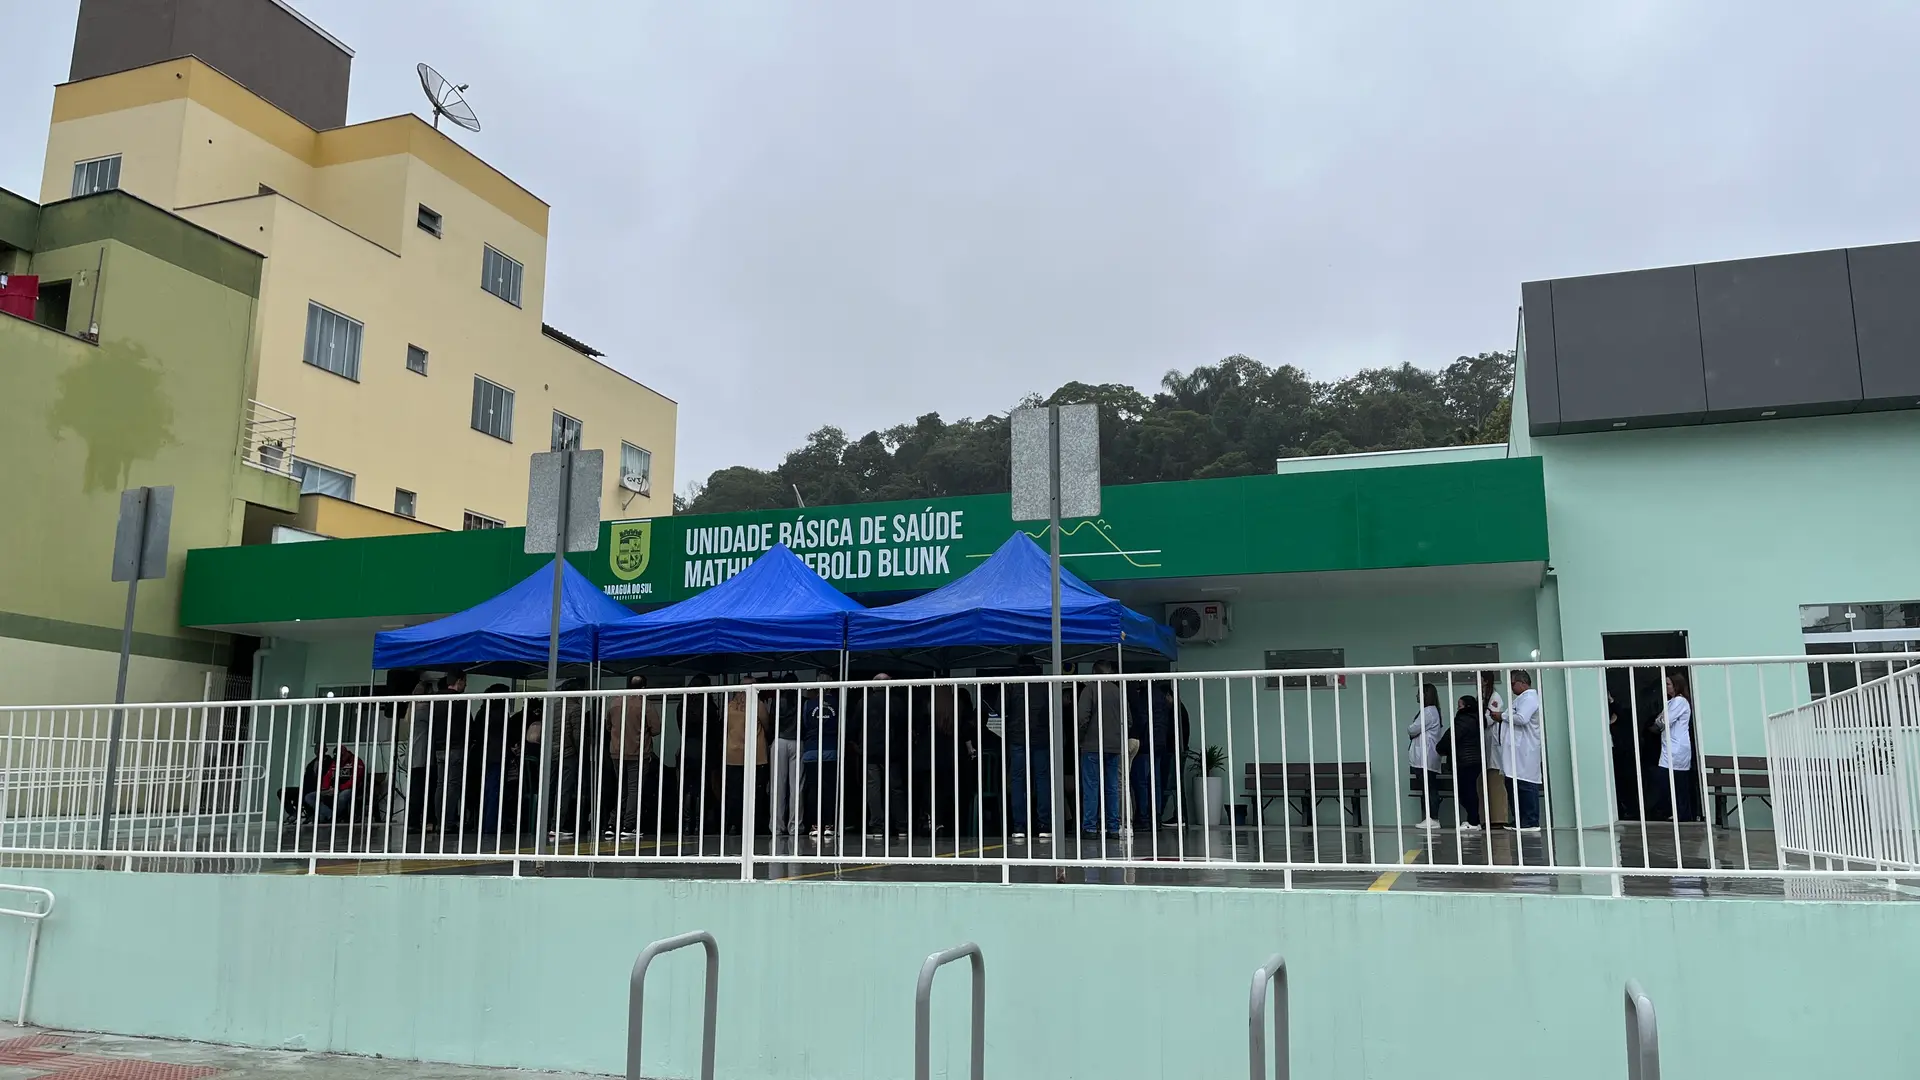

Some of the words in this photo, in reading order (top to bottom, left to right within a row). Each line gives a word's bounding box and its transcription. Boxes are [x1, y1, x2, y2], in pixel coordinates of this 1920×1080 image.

[685, 523, 773, 555] UNIDADE
[779, 515, 853, 549] BÁSICA
[860, 516, 887, 545] DE
[892, 506, 963, 543] SAÚDE
[632, 583, 640, 594] DO
[641, 582, 652, 594] SUL
[684, 557, 753, 588] MATH
[878, 546, 950, 577] BLUNK
